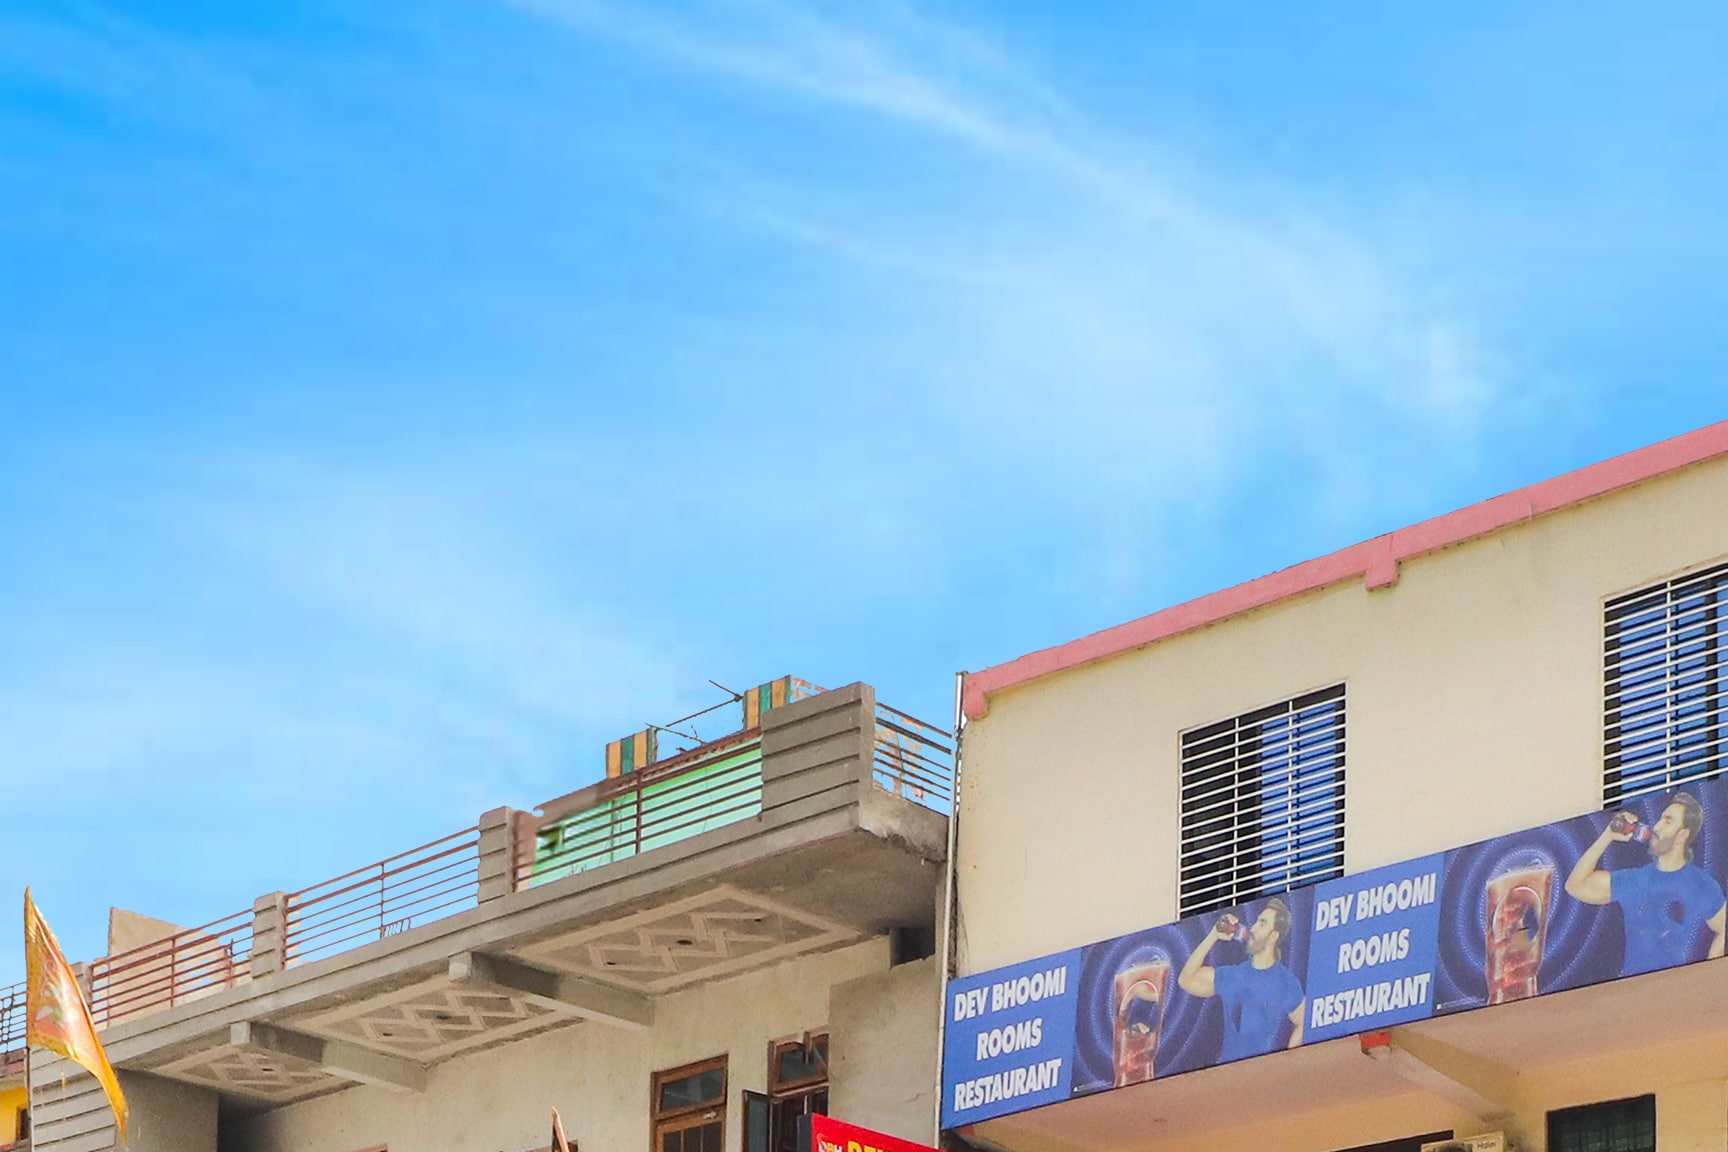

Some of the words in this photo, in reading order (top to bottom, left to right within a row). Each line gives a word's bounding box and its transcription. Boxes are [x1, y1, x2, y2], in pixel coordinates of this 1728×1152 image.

[1316, 894, 1354, 932] DEV
[1356, 872, 1437, 922] BHOOMI
[1337, 928, 1411, 974] ROOMS
[954, 986, 989, 1022] DEV
[991, 966, 1066, 1012] BHOOMI
[1311, 973, 1431, 1029] RESTAURANT
[976, 1018, 1043, 1060] ROOMS
[953, 1058, 1062, 1112] RESTAURANT
